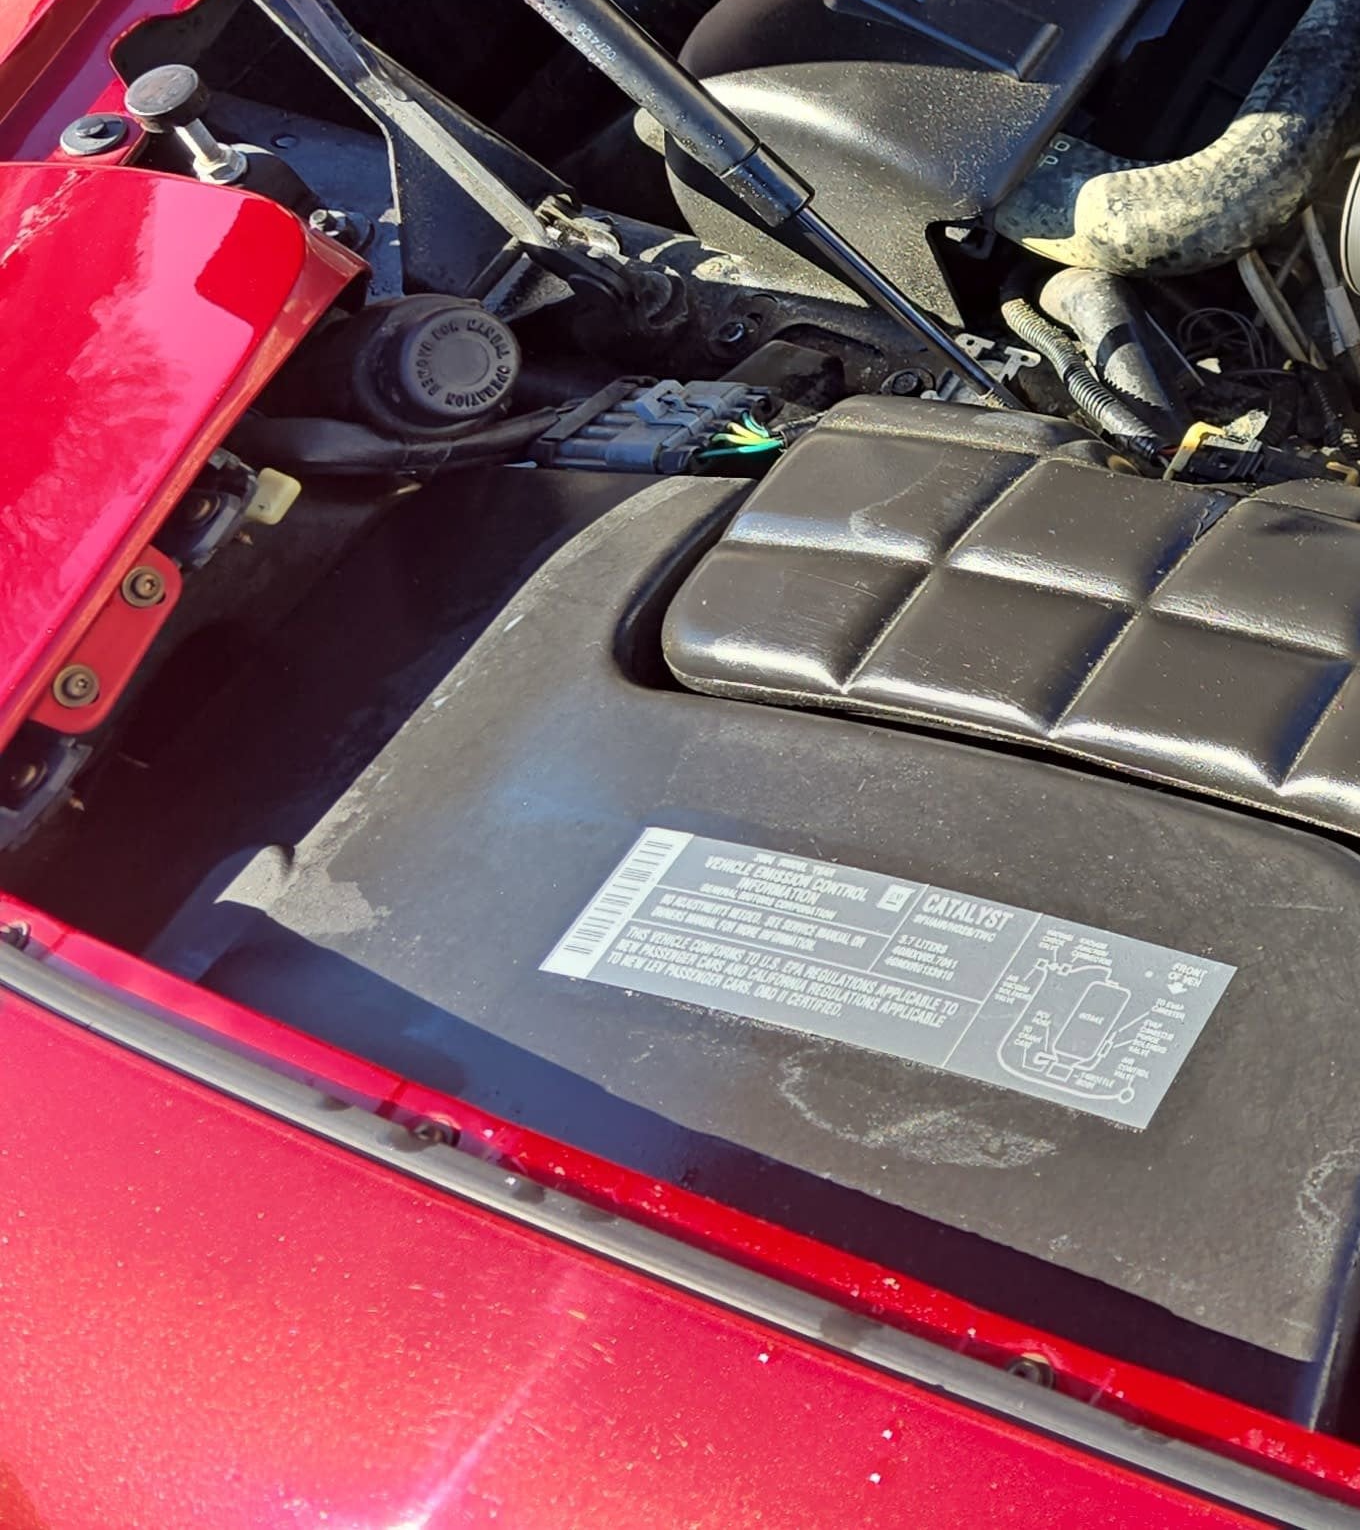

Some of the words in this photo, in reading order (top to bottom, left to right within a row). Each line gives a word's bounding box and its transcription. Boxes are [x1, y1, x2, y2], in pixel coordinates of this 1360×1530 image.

[704, 855, 755, 875] VEHICLE
[752, 865, 813, 887] EMISSION
[811, 877, 868, 901] CONTROL
[736, 876, 820, 904] INFORMATION
[922, 890, 1013, 930] CATALYST
[716, 919, 737, 932] FOR
[780, 918, 818, 936] SERVICE
[814, 926, 851, 944] MANUAL
[850, 935, 866, 948] OR
[913, 937, 948, 954] LITERS
[606, 950, 623, 964] TO
[619, 954, 648, 969] NEW
[643, 959, 667, 973] LEV
[663, 963, 723, 986] PASSENGER
[721, 976, 752, 994] CARS.
[752, 983, 778, 1000] OBD
[785, 991, 842, 1016] CERTIFIED.
[615, 938, 642, 953] NEW
[638, 943, 698, 965] PASSENGER
[695, 955, 726, 972] CARS
[722, 961, 749, 977] AND
[747, 967, 808, 991] CALIFORNIA
[806, 981, 880, 1010] REGULATIONS
[878, 1000, 946, 1028] APPLICABLE
[627, 925, 651, 941] THIS
[649, 930, 691, 949] VEHICLE
[689, 938, 745, 961] CONFORMS
[744, 951, 761, 965] TO
[757, 954, 781, 970] U.S.
[781, 959, 805, 976] EPA
[803, 965, 877, 993] REGULATIONS
[874, 983, 942, 1010] APPLICABLE
[940, 999, 959, 1015] TO
[1167, 970, 1183, 981] OF
[1171, 962, 1208, 978] FRONT
